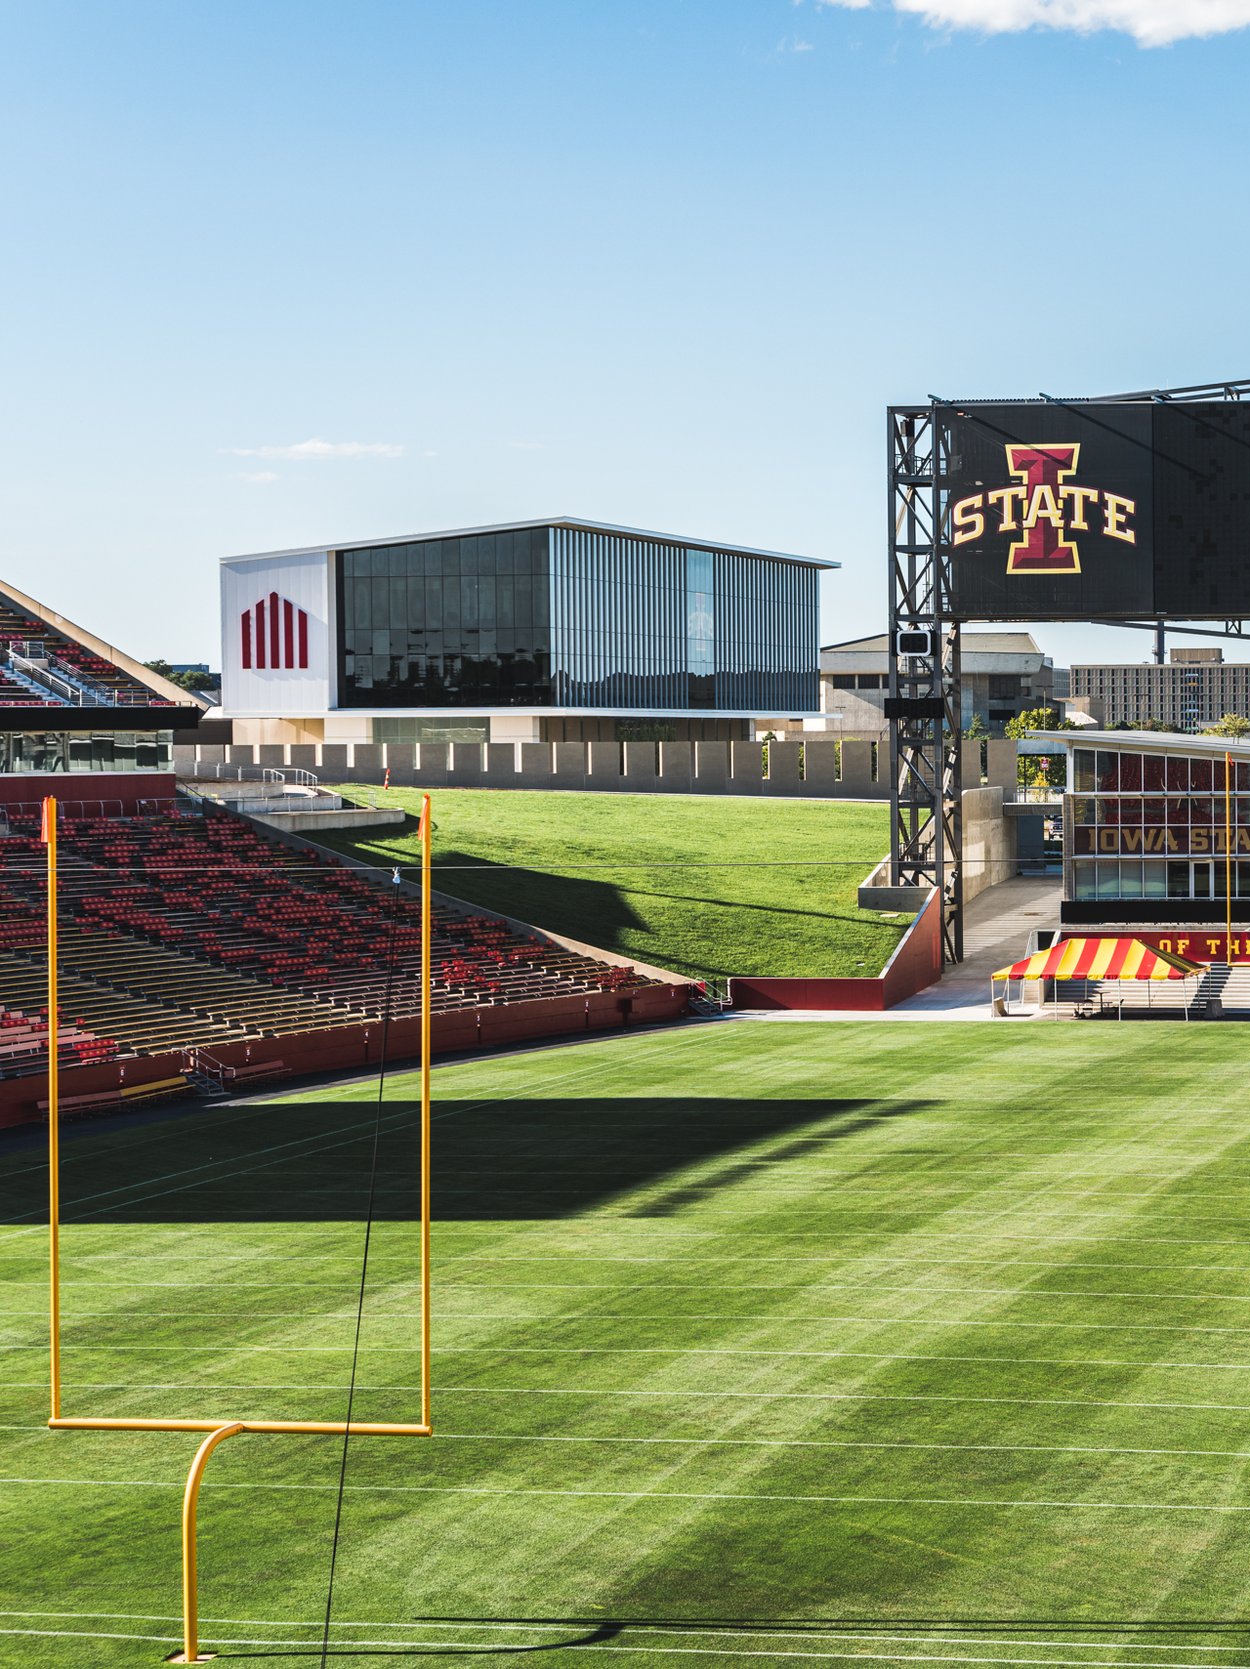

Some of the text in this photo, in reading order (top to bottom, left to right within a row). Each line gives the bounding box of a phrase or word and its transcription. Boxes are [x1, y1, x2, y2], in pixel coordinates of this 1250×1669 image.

[953, 484, 1136, 546] STATE
[1088, 828, 1179, 851] IOWA
[1158, 939, 1190, 955] OF
